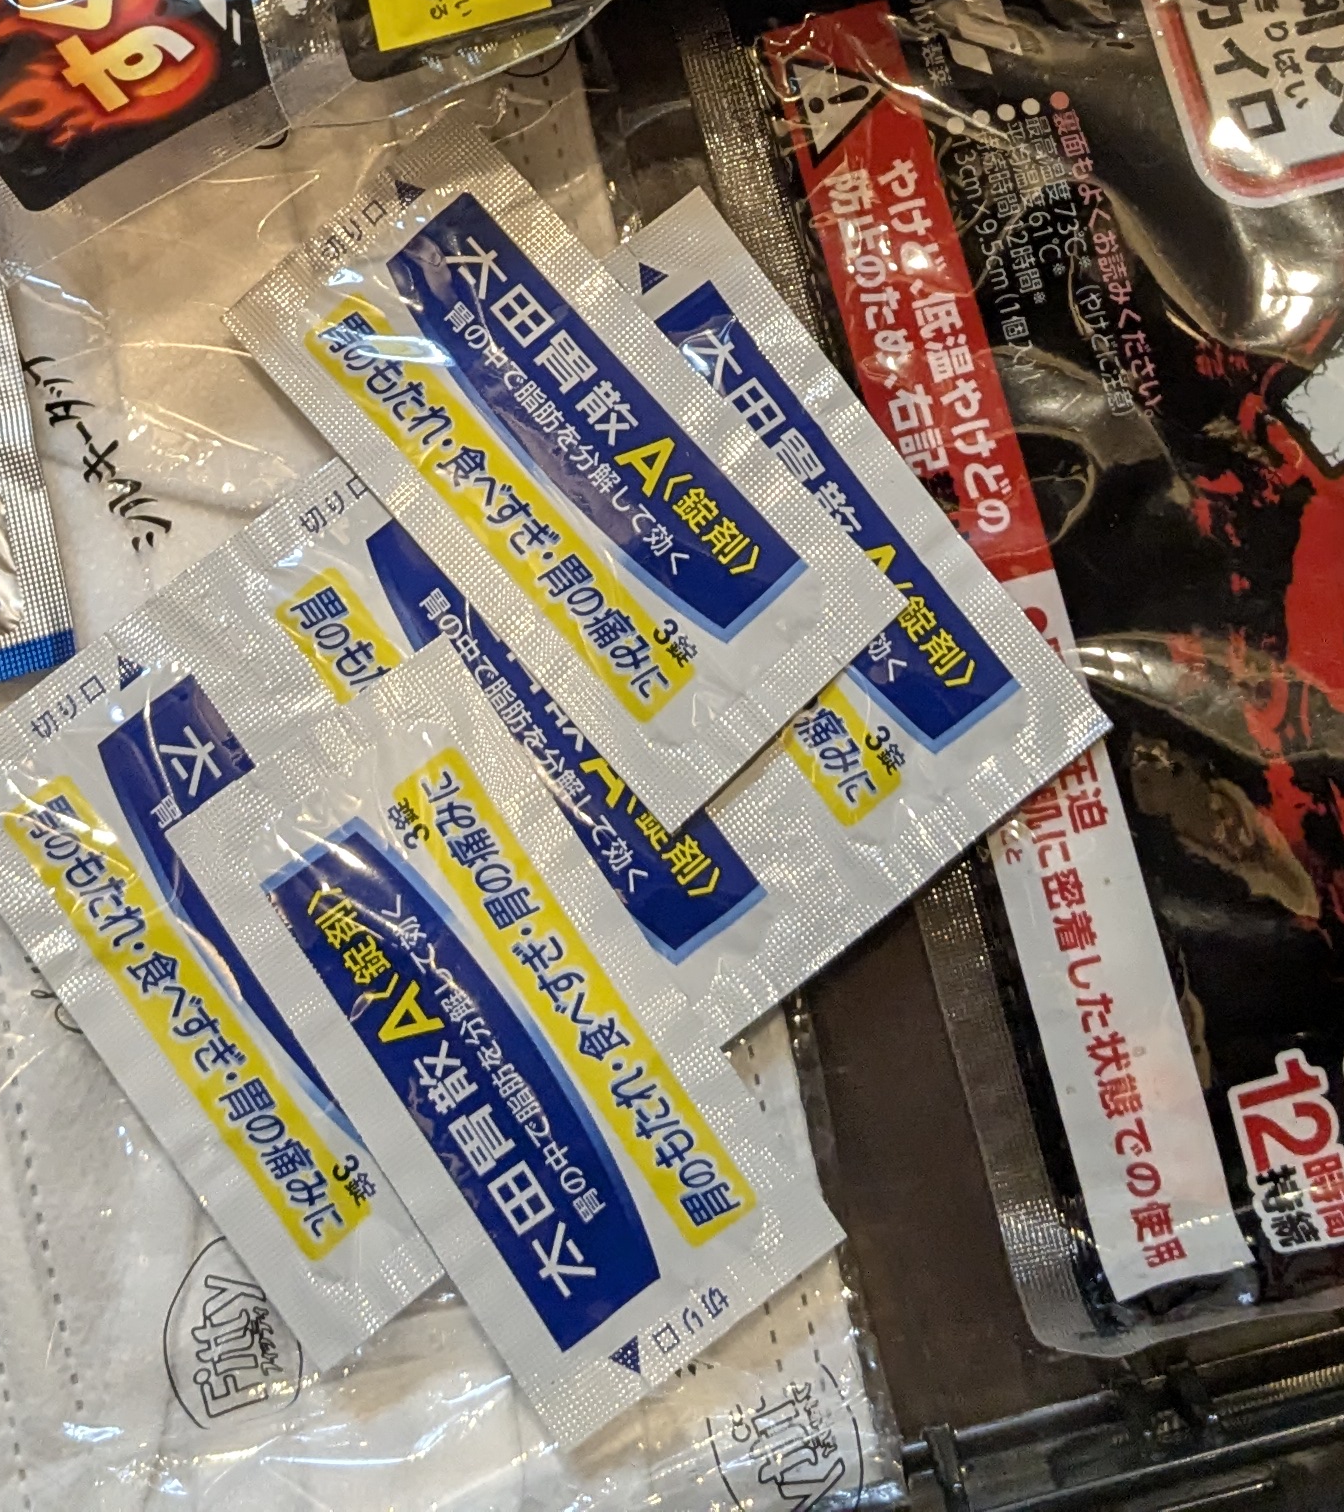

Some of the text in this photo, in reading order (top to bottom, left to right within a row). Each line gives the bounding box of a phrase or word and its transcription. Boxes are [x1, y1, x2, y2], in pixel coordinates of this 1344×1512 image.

[320, 197, 387, 264] 切り口
[445, 236, 639, 443] 太田胃散
[878, 158, 1011, 536] やけど、低温やけどの
[442, 300, 694, 575] 胃の中で脂肪を分解して効く
[317, 313, 673, 700] 胃のもたれ・食べすぎ・胃の痛みに
[652, 617, 699, 670] 3錠
[31, 675, 106, 740] 切り口
[159, 725, 223, 798] 太
[863, 724, 907, 776] 3錠
[387, 797, 430, 851] 3錠
[22, 789, 346, 1240] 胃のもたれ・食べすぎ・胃の痛みに
[421, 769, 744, 1227] 胃のもたれ・食べすぎ・胃の痛みに
[330, 1152, 379, 1209] 3錠
[412, 1050, 599, 1303] 太田胃散
[191, 1273, 267, 1419] Fitty
[654, 1284, 733, 1355] 切り口
